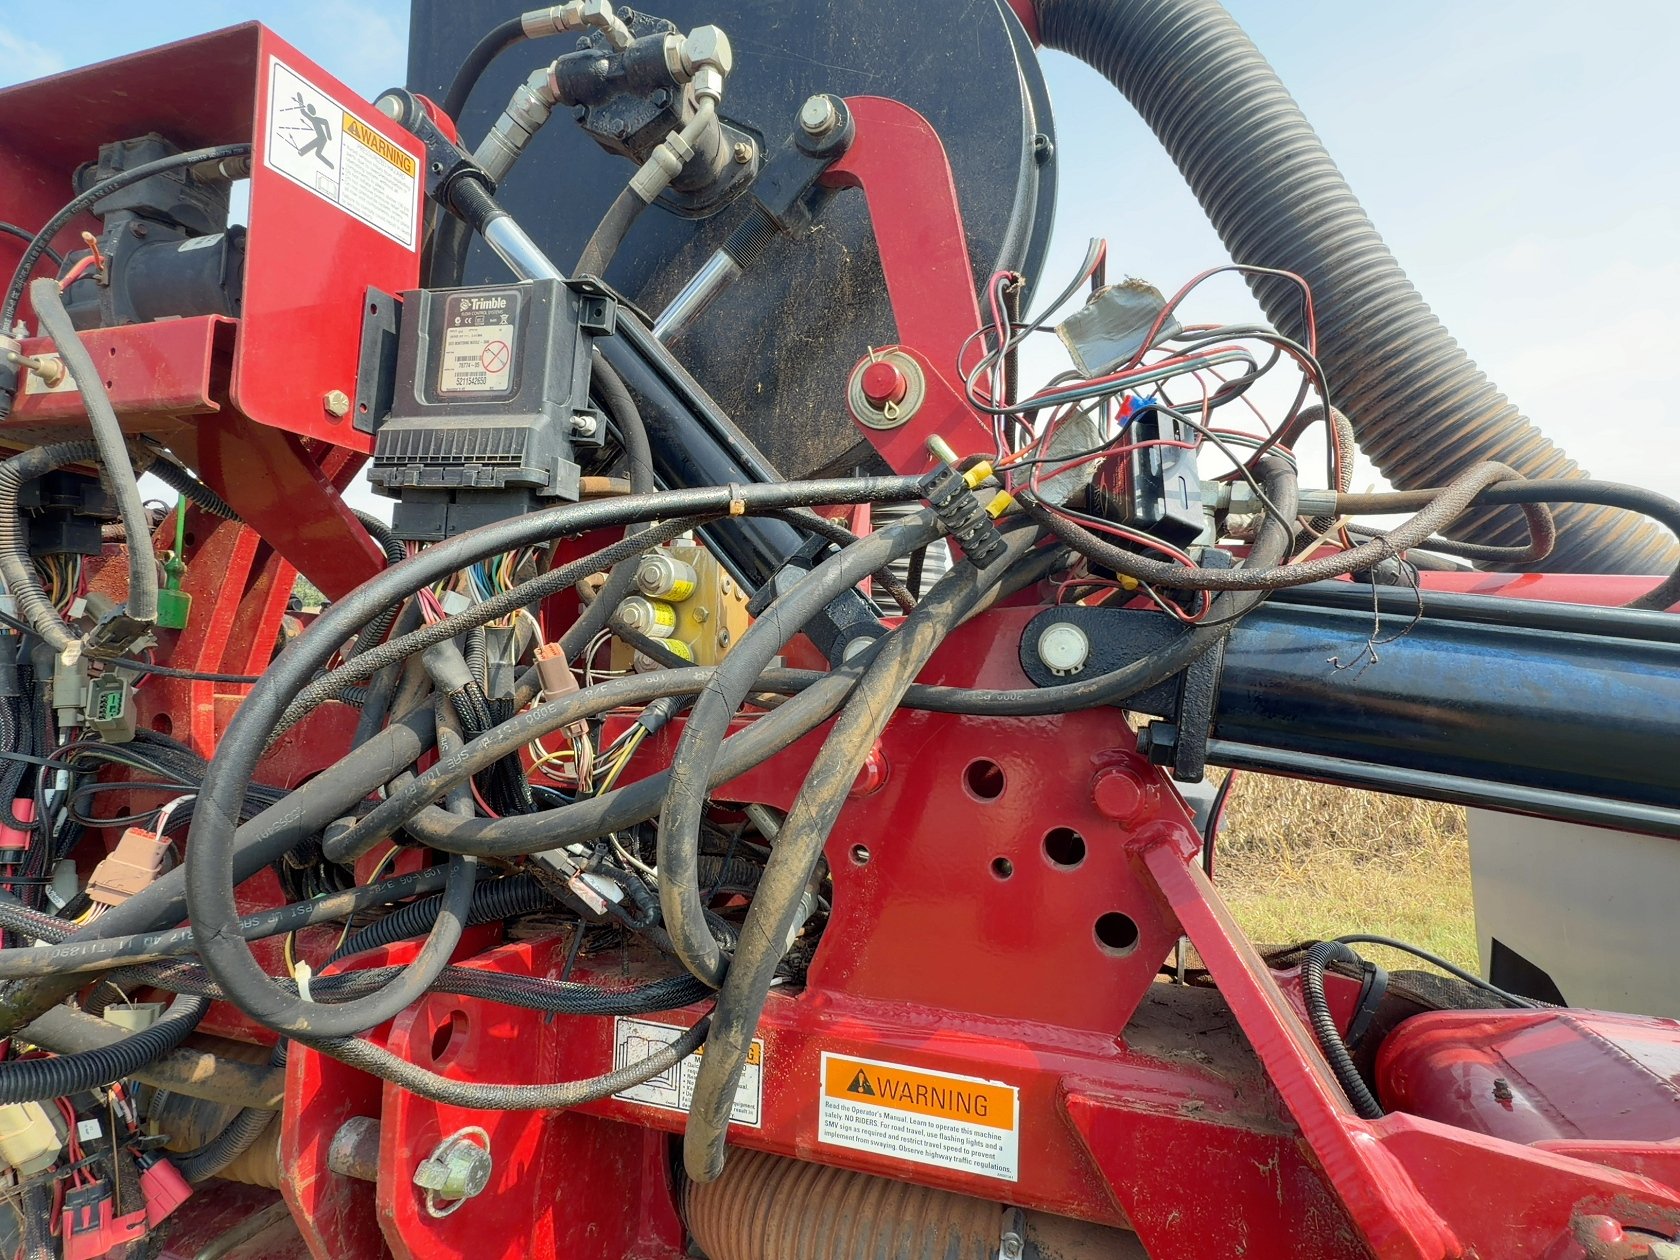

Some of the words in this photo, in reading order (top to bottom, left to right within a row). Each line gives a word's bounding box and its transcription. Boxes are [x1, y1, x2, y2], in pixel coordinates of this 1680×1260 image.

[360, 126, 411, 172] WARNING
[472, 296, 506, 310] Trimble
[420, 768, 440, 786] 100
[446, 750, 470, 771] SAE
[290, 905, 312, 918] PSI
[877, 1076, 988, 1117] WARNING
[824, 1112, 844, 1120] safely.
[855, 1116, 880, 1127] RIDERS.
[906, 1127, 926, 1137] travel,
[940, 1132, 964, 1145] flashing
[966, 1138, 984, 1148] lights
[825, 1101, 840, 1110] Read
[840, 1104, 850, 1112] the
[852, 1106, 882, 1118] Operator's
[884, 1112, 909, 1124] Manual.
[910, 1117, 927, 1127] Learn
[936, 1124, 960, 1132] operate
[960, 1126, 972, 1136] this
[974, 1130, 1002, 1140] machine
[824, 1120, 838, 1128] SMV
[840, 1124, 852, 1132] sign
[862, 1128, 886, 1139] required
[900, 1136, 923, 1146] restrict
[924, 1140, 942, 1150] travel
[942, 1144, 962, 1152] speed
[971, 1150, 996, 1160] prevent
[824, 1129, 854, 1140] implement
[856, 1136, 870, 1144] from
[870, 1140, 898, 1152] swaying.
[898, 1144, 924, 1156] Observe
[925, 1149, 952, 1162] highway
[954, 1156, 972, 1166] traffic
[974, 1160, 1012, 1174] regulations.
